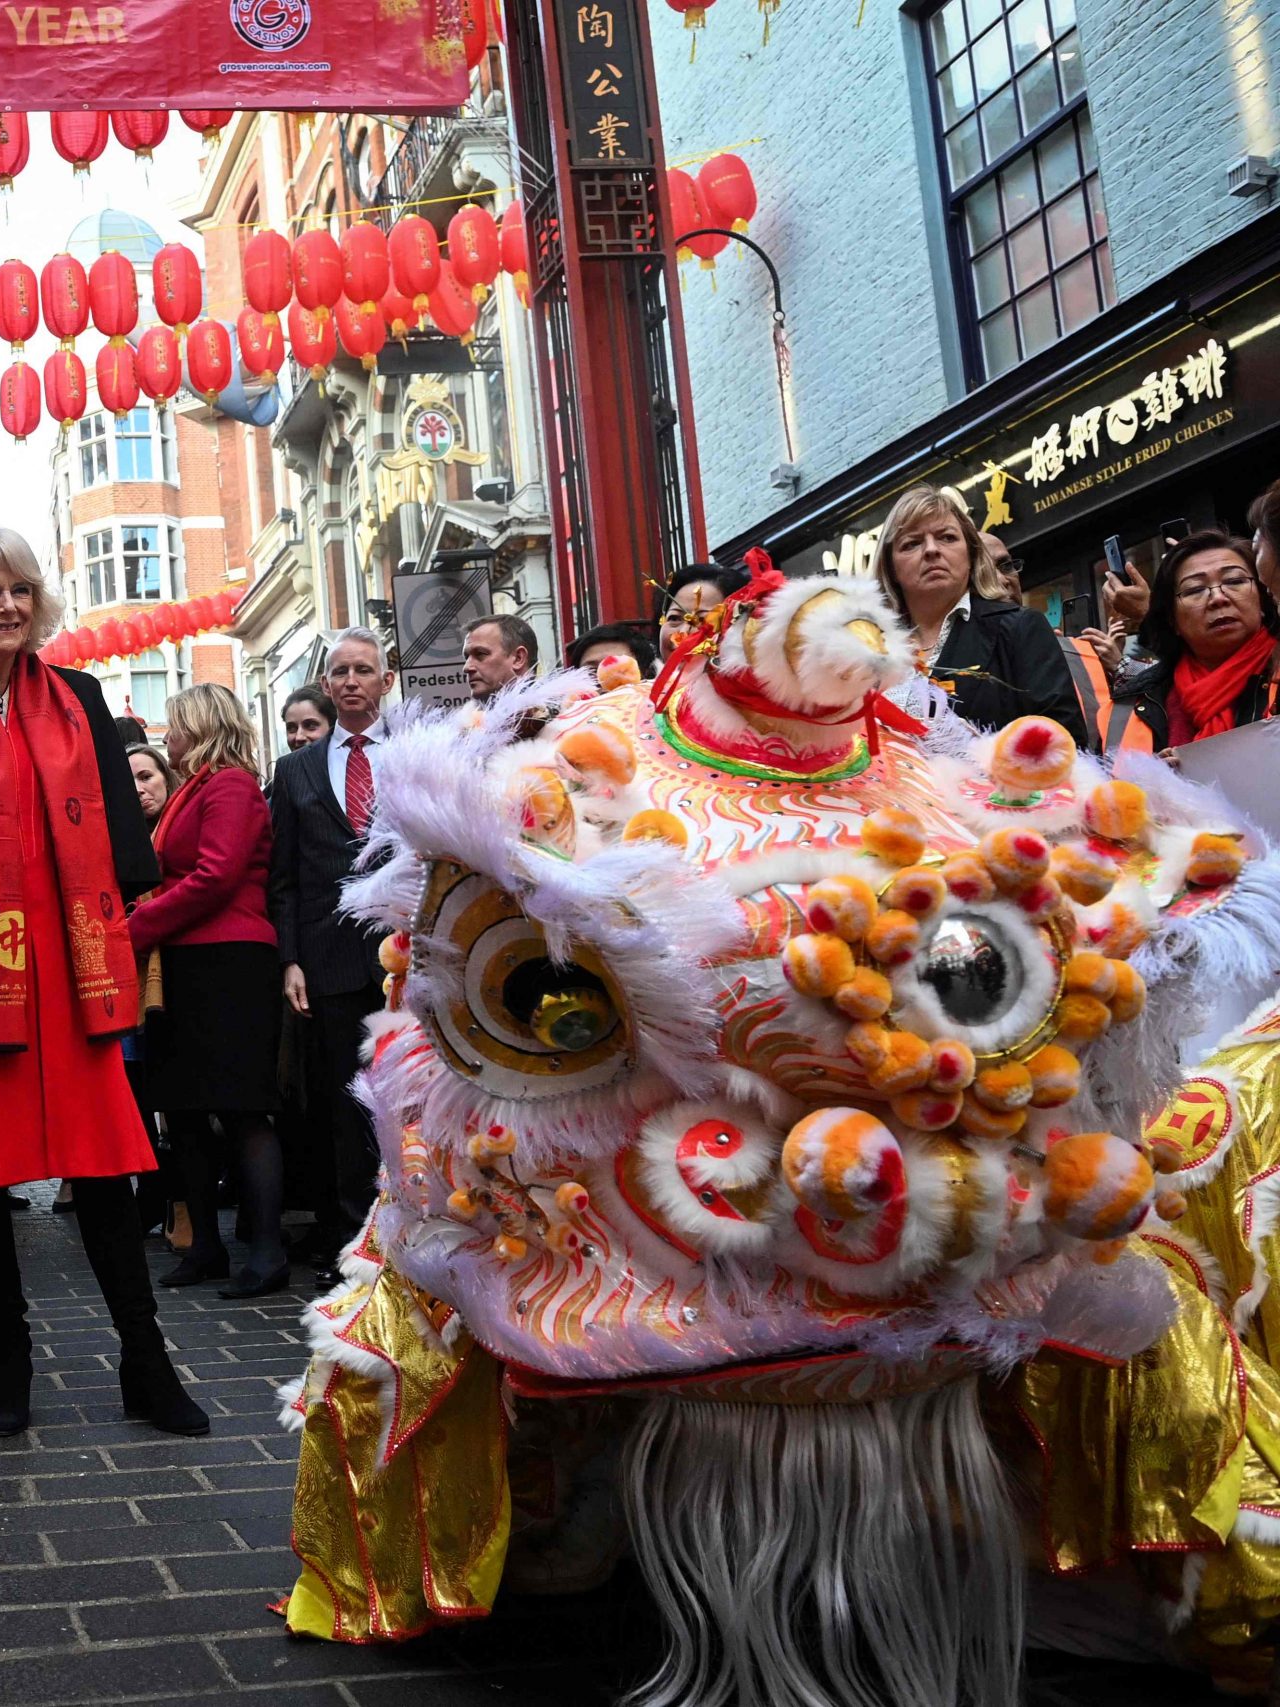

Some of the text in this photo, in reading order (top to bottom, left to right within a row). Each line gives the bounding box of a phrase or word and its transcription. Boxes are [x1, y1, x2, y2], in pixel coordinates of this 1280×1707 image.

[4, 6, 128, 46] YEAR
[248, 25, 296, 42] CASINOS
[219, 62, 330, 73] grosvenorcasinos.com
[1033, 407, 1234, 513] TAIWANESE STYLE FRIED CHICKEN
[408, 671, 468, 689] Pedestr
